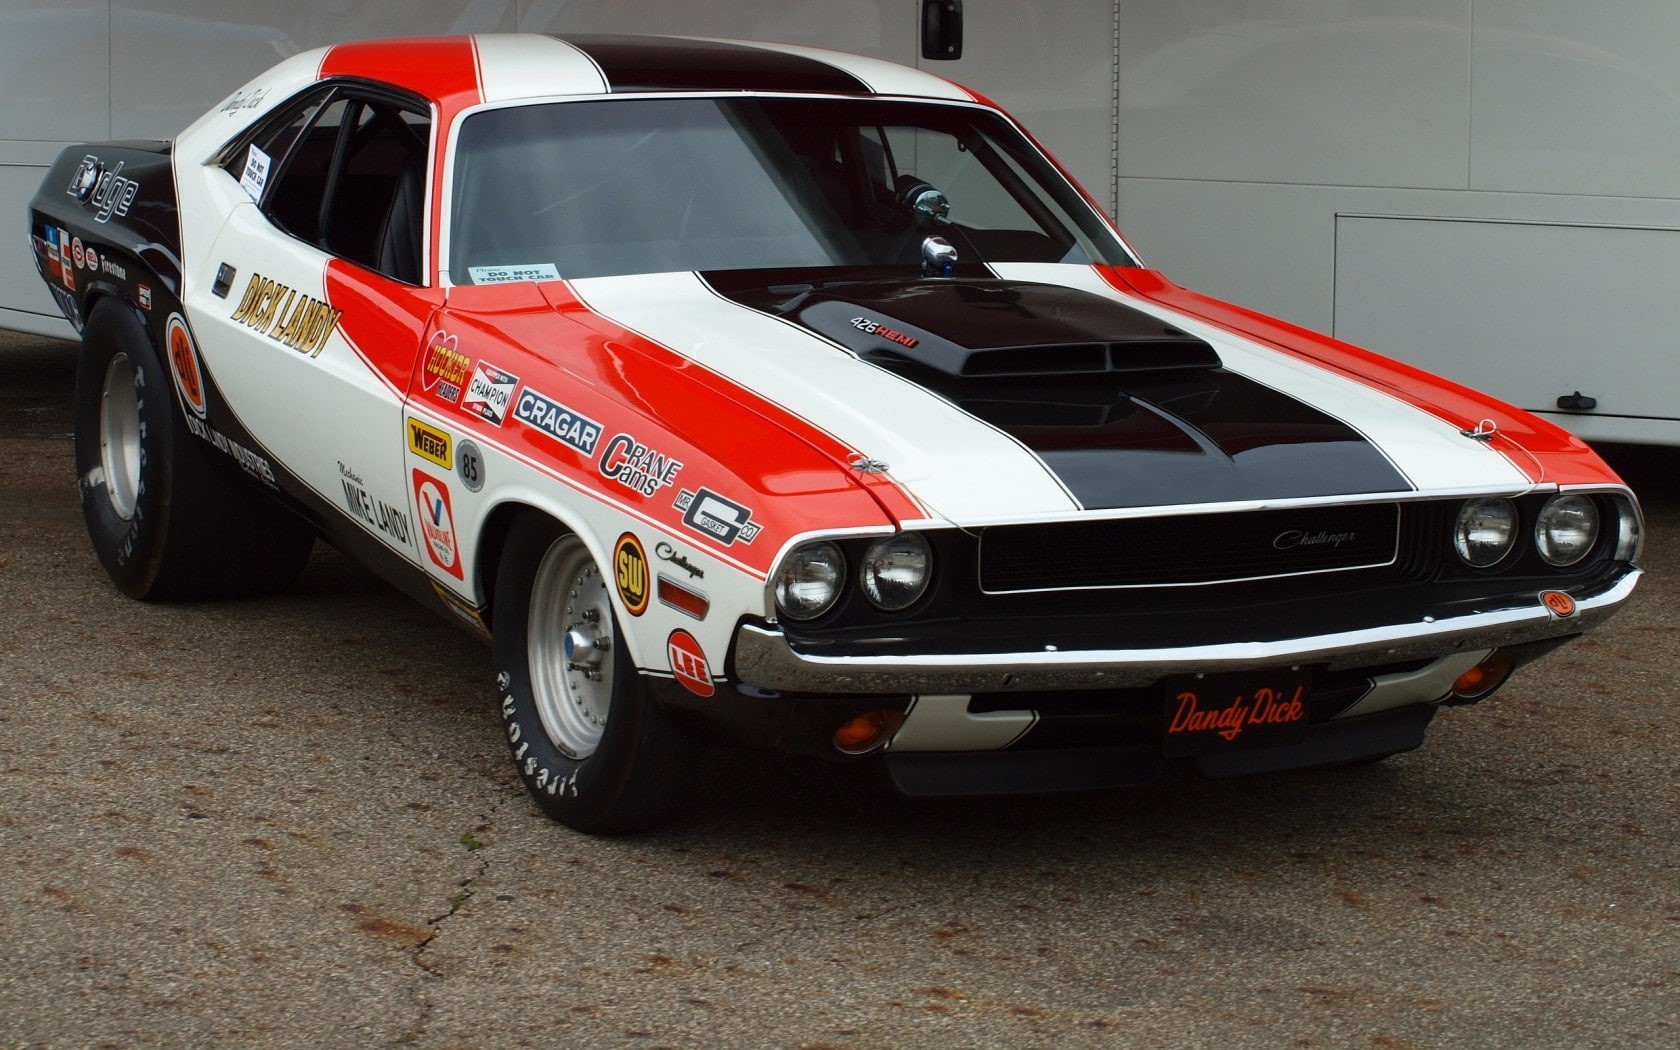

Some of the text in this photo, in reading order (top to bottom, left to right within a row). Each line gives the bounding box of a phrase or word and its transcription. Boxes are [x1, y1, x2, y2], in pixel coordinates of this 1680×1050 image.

[67, 154, 139, 224] Ddge
[230, 272, 344, 359] DICK LANDY
[849, 316, 919, 349] 426 HEMI
[426, 344, 471, 386] HOOKER
[470, 378, 510, 408] CHAMPION
[410, 423, 448, 462] WEBER
[518, 394, 598, 452] CRAGAR
[463, 453, 478, 482] 85
[599, 433, 685, 486] CRANE
[369, 494, 413, 548] LANDY
[700, 516, 726, 534] GASKET
[1272, 530, 1356, 550] Challenger
[619, 550, 643, 596] SW
[655, 541, 705, 579] Challenger
[671, 646, 710, 684] LEE
[1168, 685, 1304, 741] Dandy Dick
